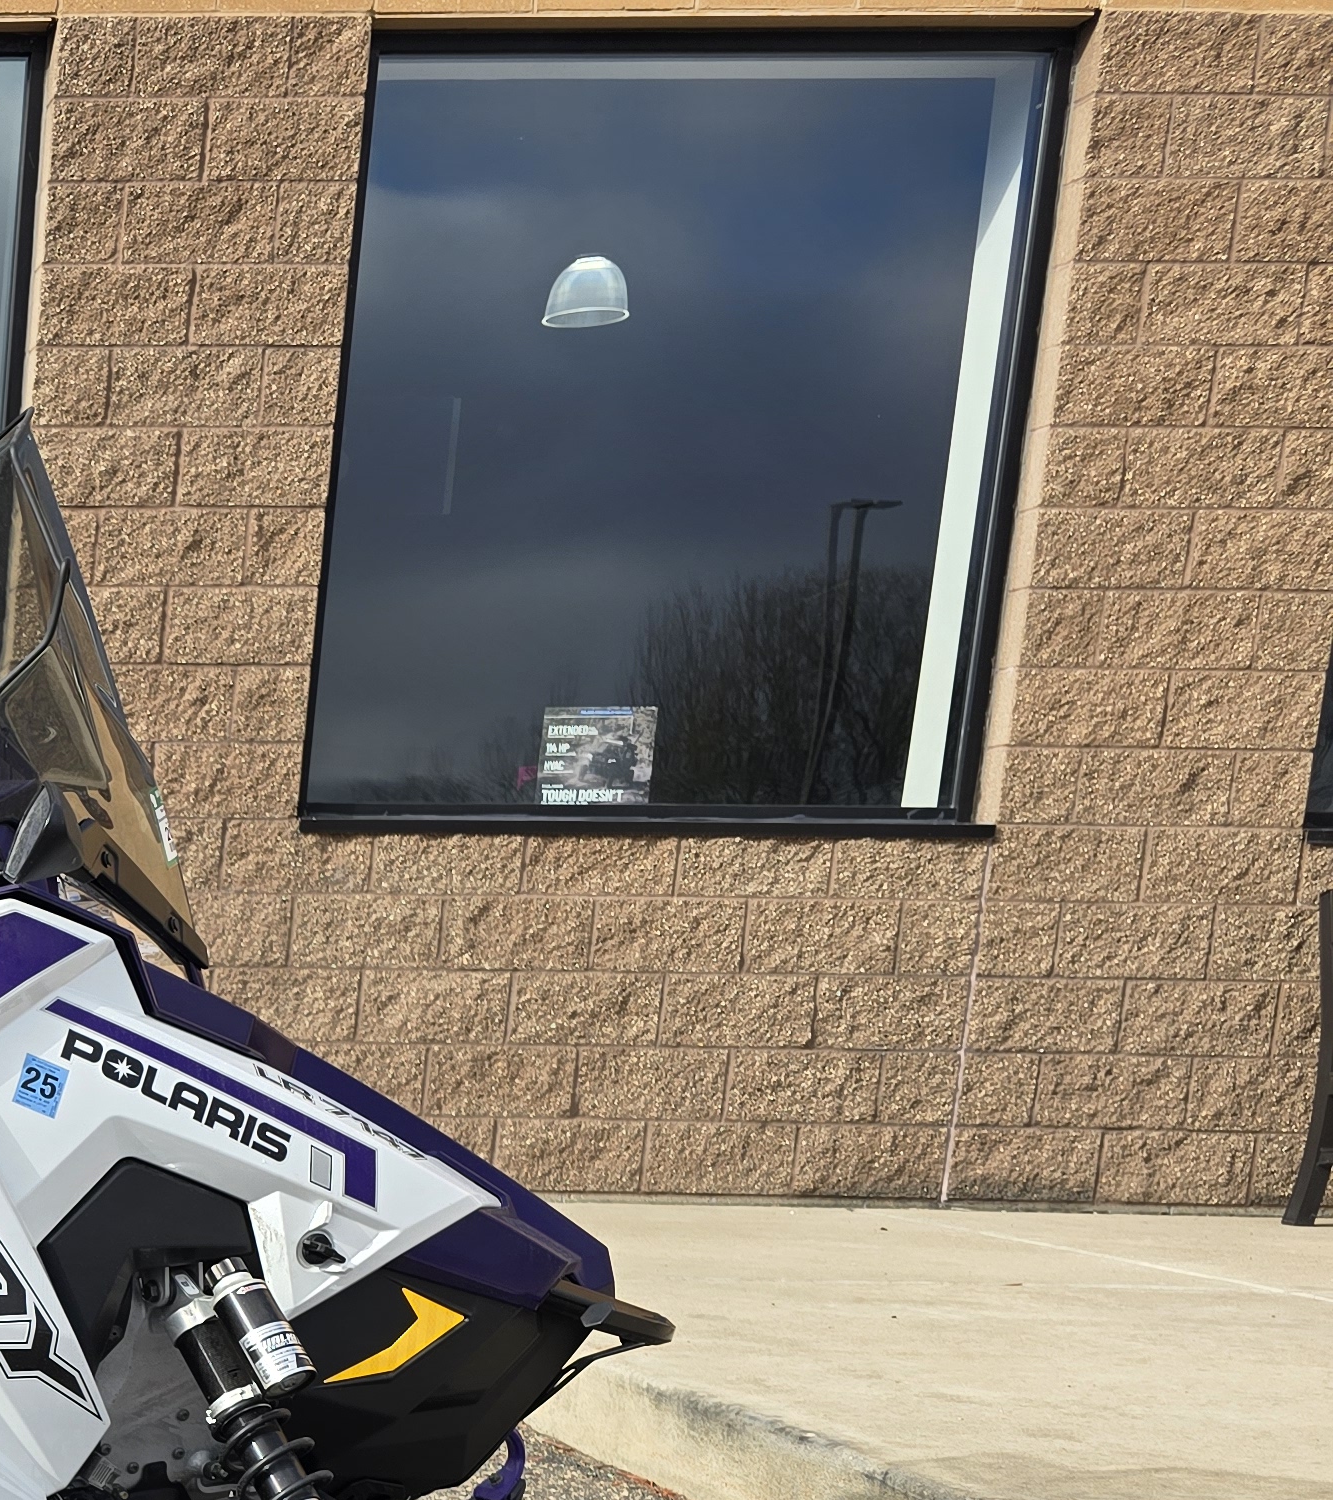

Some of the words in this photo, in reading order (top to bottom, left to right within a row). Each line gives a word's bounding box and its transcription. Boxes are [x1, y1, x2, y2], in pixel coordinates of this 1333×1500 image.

[548, 725, 589, 736] EXTENDED
[541, 789, 577, 802] TOUGH
[577, 789, 624, 803] DOESN'T
[20, 1066, 59, 1099] 25
[60, 1028, 292, 1162] POLARIS
